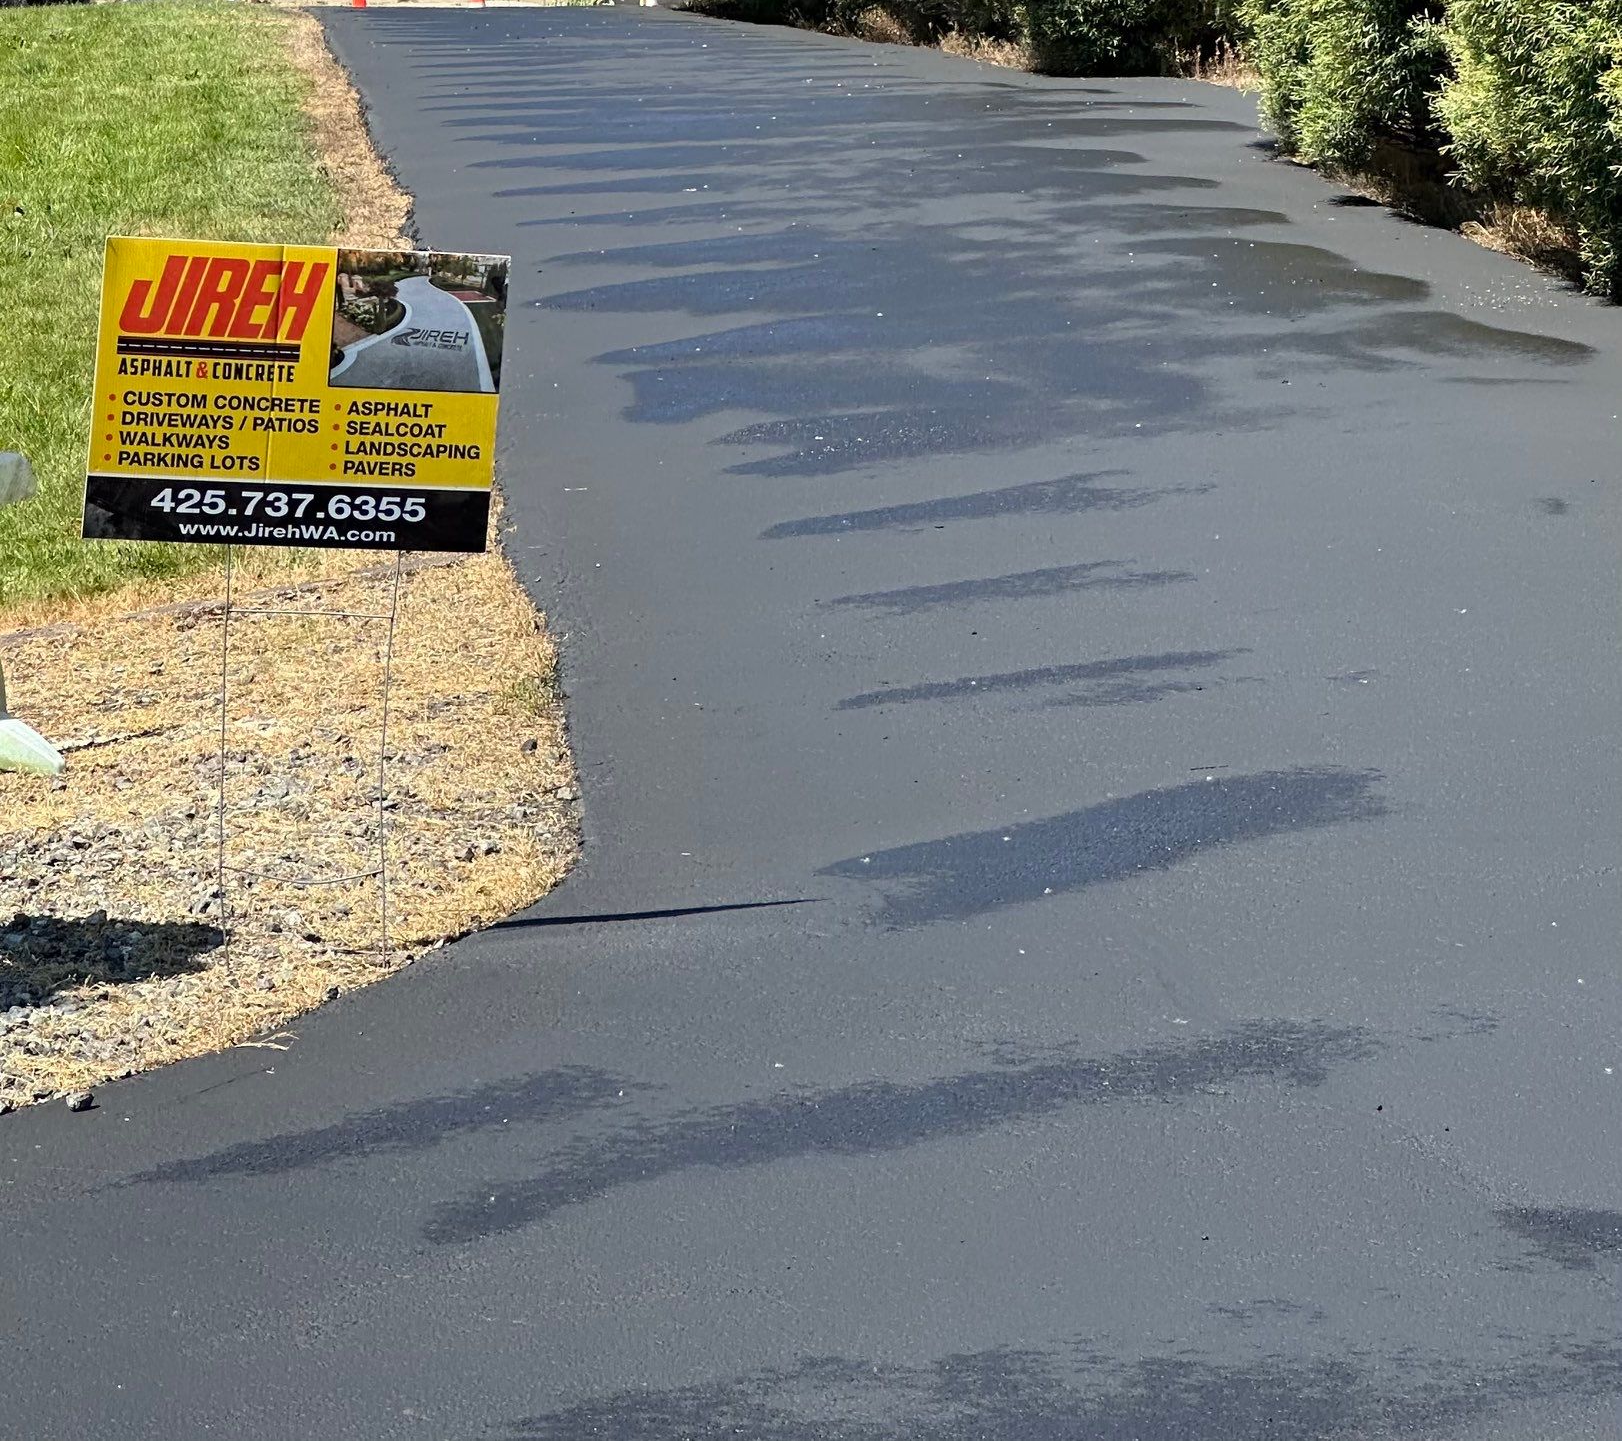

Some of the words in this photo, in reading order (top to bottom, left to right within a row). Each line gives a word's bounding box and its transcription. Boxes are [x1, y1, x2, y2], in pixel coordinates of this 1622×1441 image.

[119, 255, 328, 340] JIREH
[410, 330, 469, 344] JIREH
[118, 358, 193, 378] ASPHALT
[195, 361, 208, 379] &
[212, 362, 295, 383] CONCRETE
[123, 390, 207, 409] CUSTOM
[213, 394, 321, 413] CONCRETE
[347, 401, 433, 418] ASPHALT
[121, 411, 234, 430] DRIVEWAYS
[238, 416, 247, 431] /
[252, 416, 320, 434] PATIOS
[345, 421, 447, 438] SEALCOAT
[119, 431, 230, 450] WALKWAYS
[345, 440, 480, 460] LANDSCAPING
[117, 451, 204, 468] PARKING
[210, 454, 260, 471] LOTS
[343, 460, 416, 477] PAVERS
[150, 487, 427, 523] 425.737.6355
[178, 522, 396, 542] www.JirehWA.com
